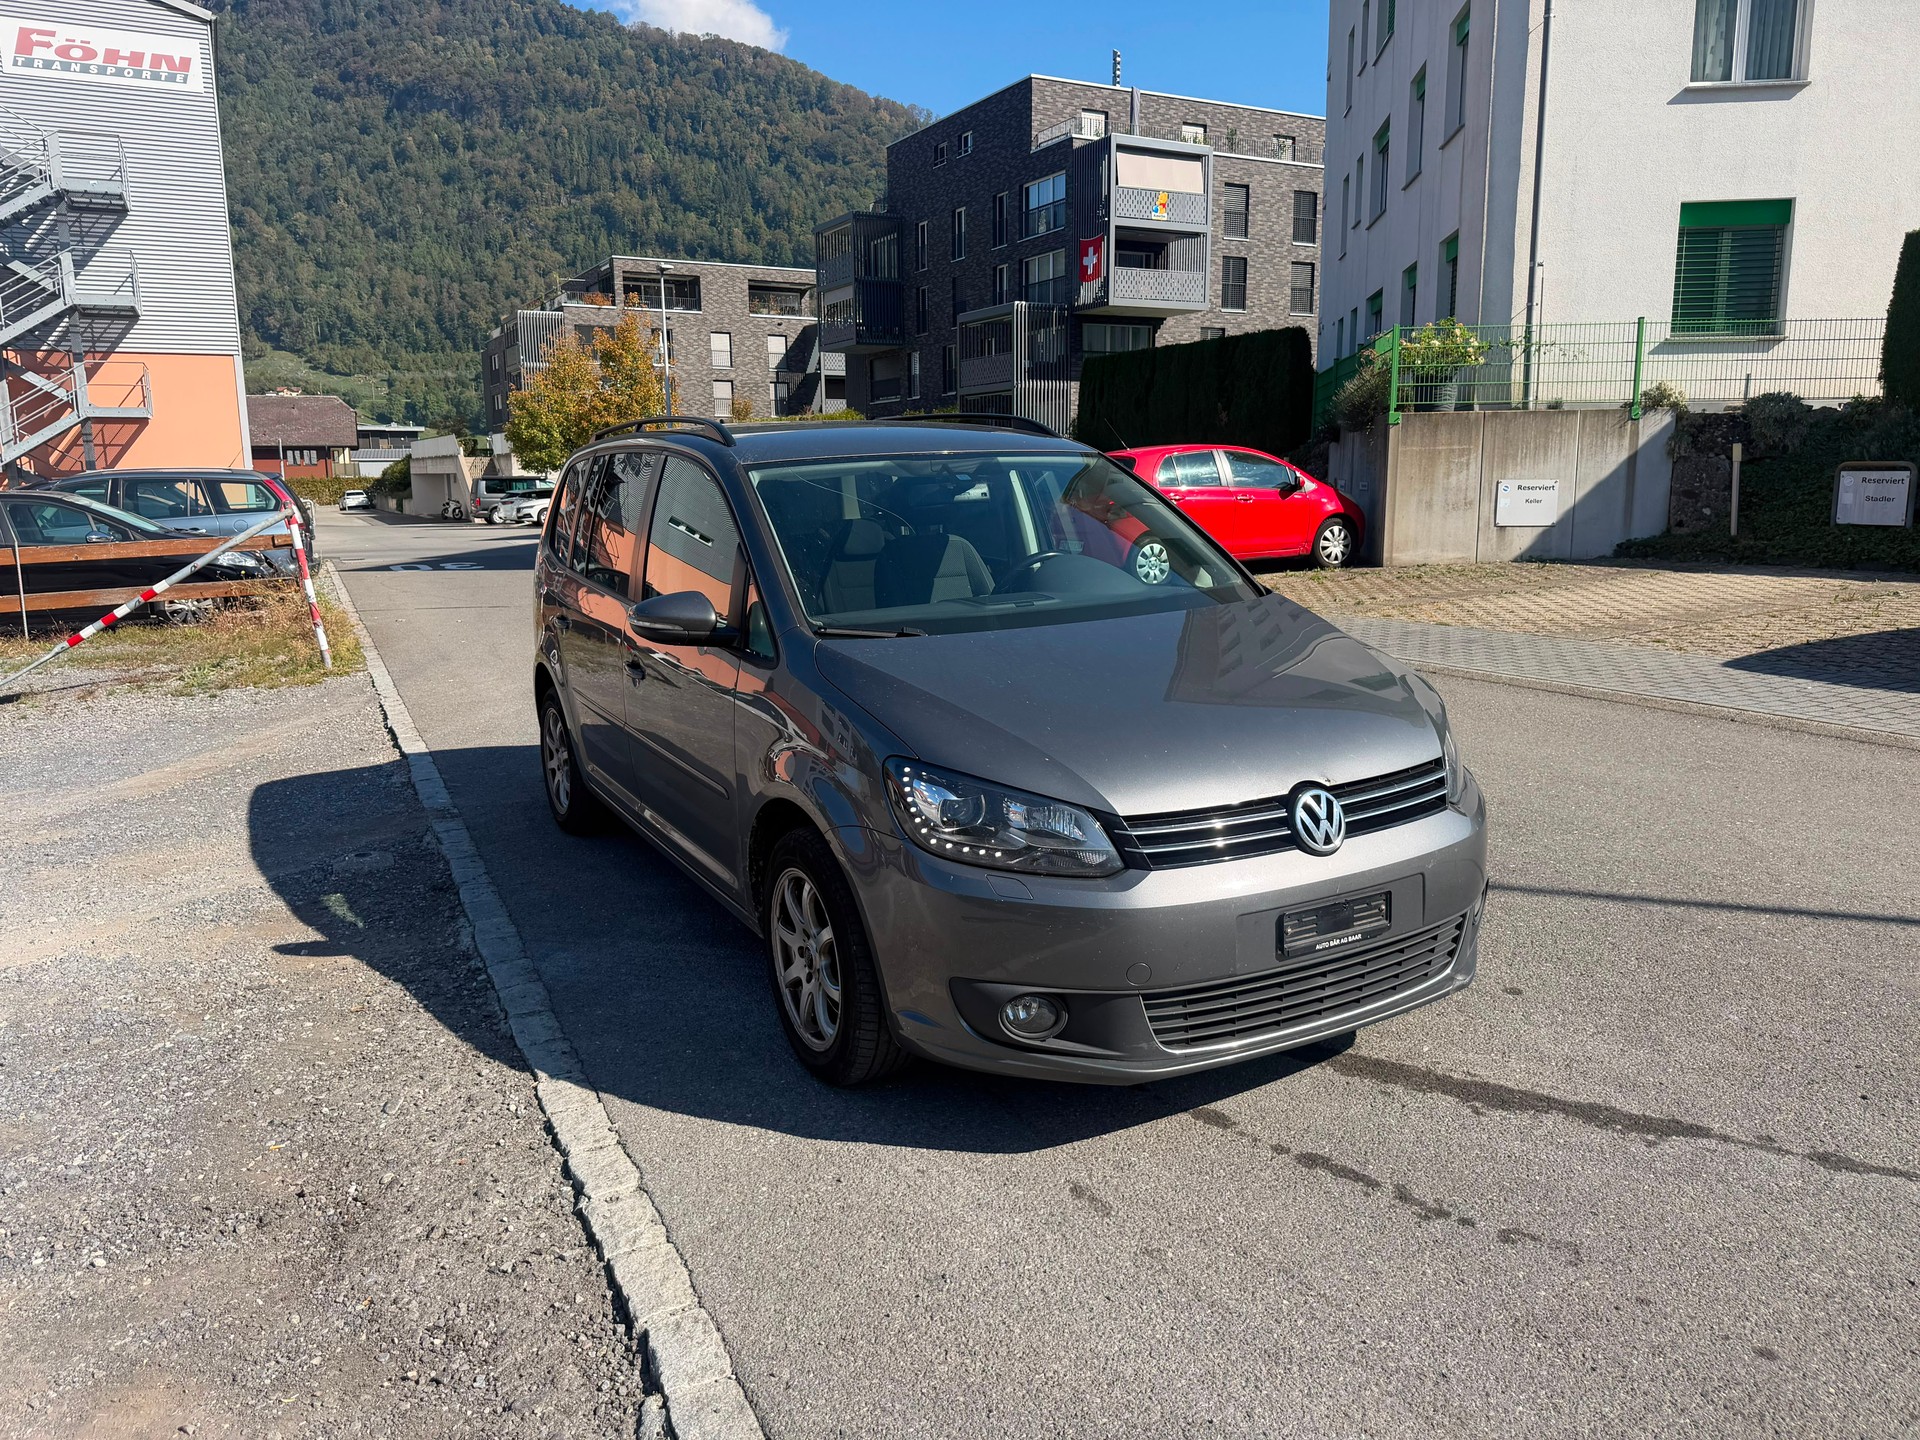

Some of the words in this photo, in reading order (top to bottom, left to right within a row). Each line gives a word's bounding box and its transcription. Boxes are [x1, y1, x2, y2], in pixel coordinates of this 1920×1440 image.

[14, 26, 192, 73] FÖHN
[14, 56, 185, 83] TRANSPORTE
[1861, 477, 1905, 485] Reserviert
[1865, 495, 1896, 503] Stadler
[1315, 941, 1330, 950] AUTO
[1341, 936, 1348, 944] AG
[1348, 933, 1362, 942] BAAR
